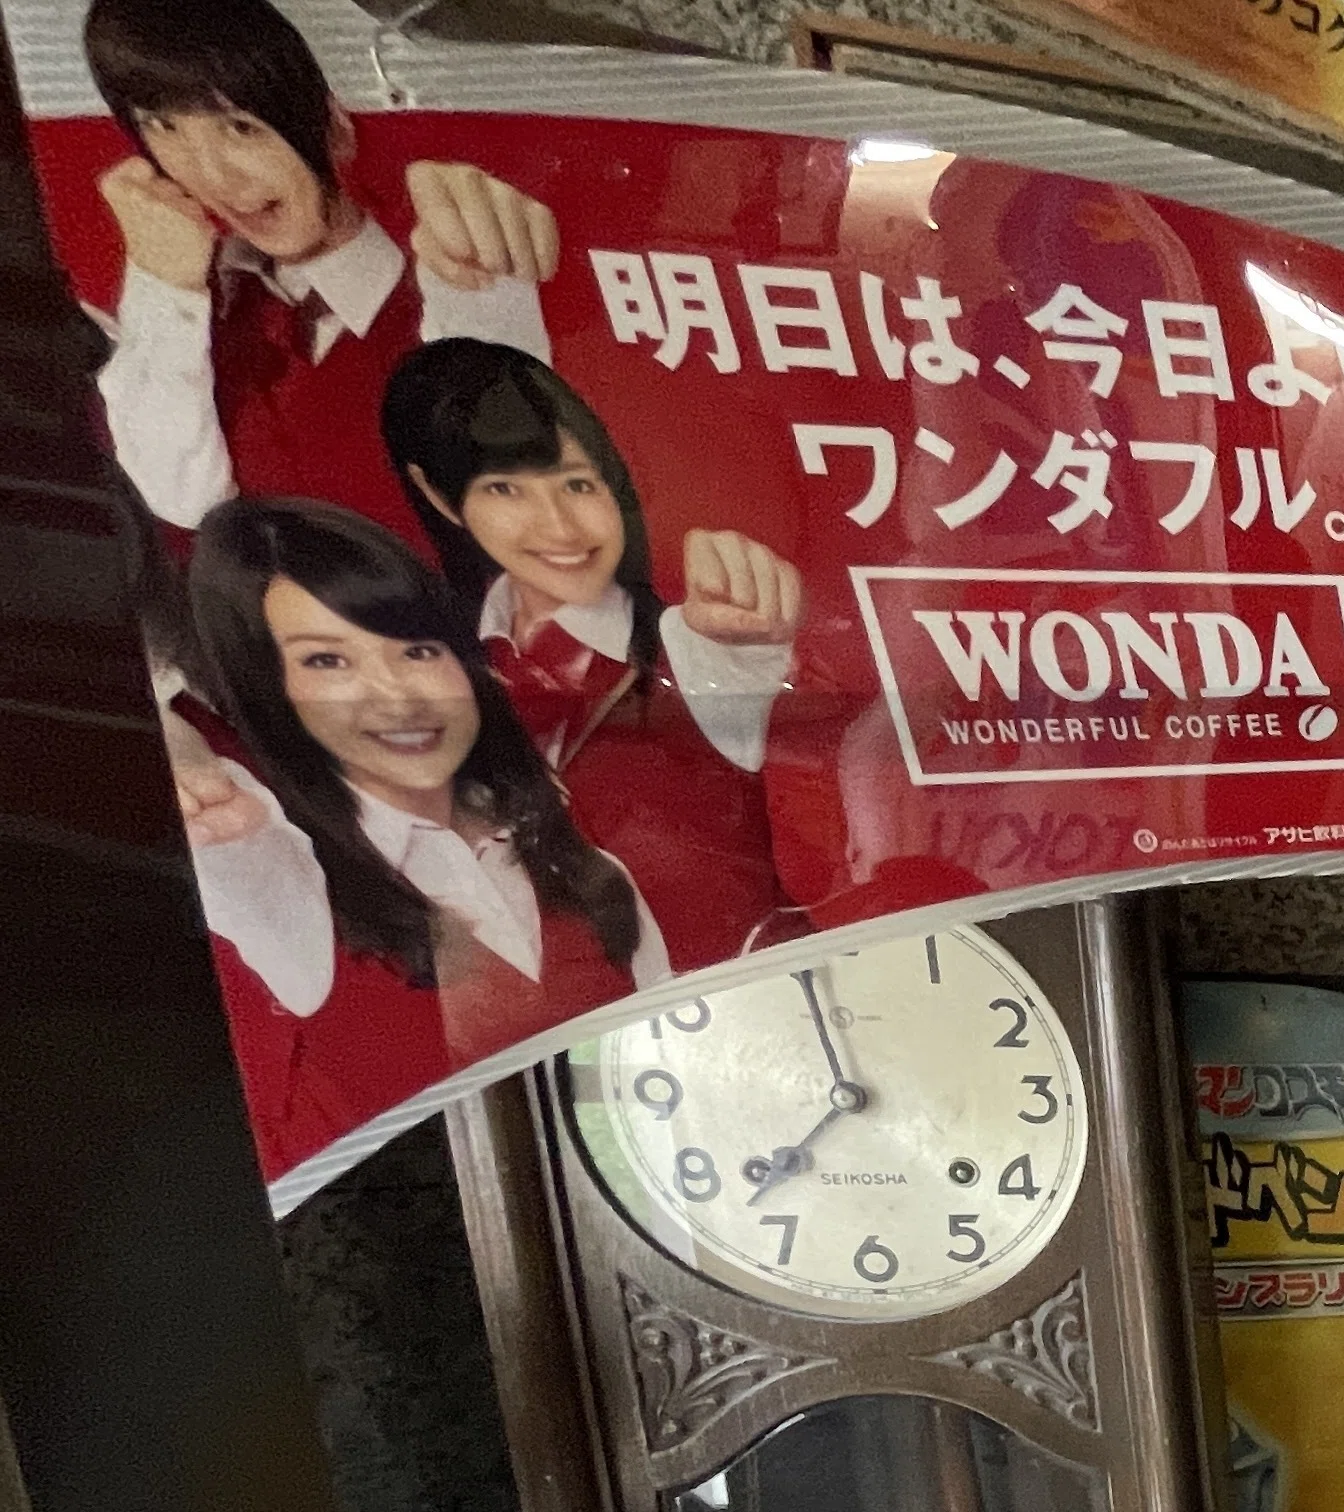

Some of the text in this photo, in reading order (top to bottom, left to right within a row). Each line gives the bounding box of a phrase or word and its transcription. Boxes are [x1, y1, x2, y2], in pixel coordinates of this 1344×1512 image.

[913, 610, 1331, 703] WONDA
[942, 705, 1284, 746] WONDERFUL COFFEE
[989, 998, 1029, 1048] 2
[633, 1069, 684, 1121] 9
[1018, 1075, 1058, 1124] 3
[673, 1147, 721, 1203] 8
[820, 1172, 908, 1187] SEIKOSHA
[998, 1154, 1041, 1201] 4
[759, 1215, 799, 1265] 7
[853, 1235, 899, 1283] 6
[946, 1214, 987, 1263] 5
